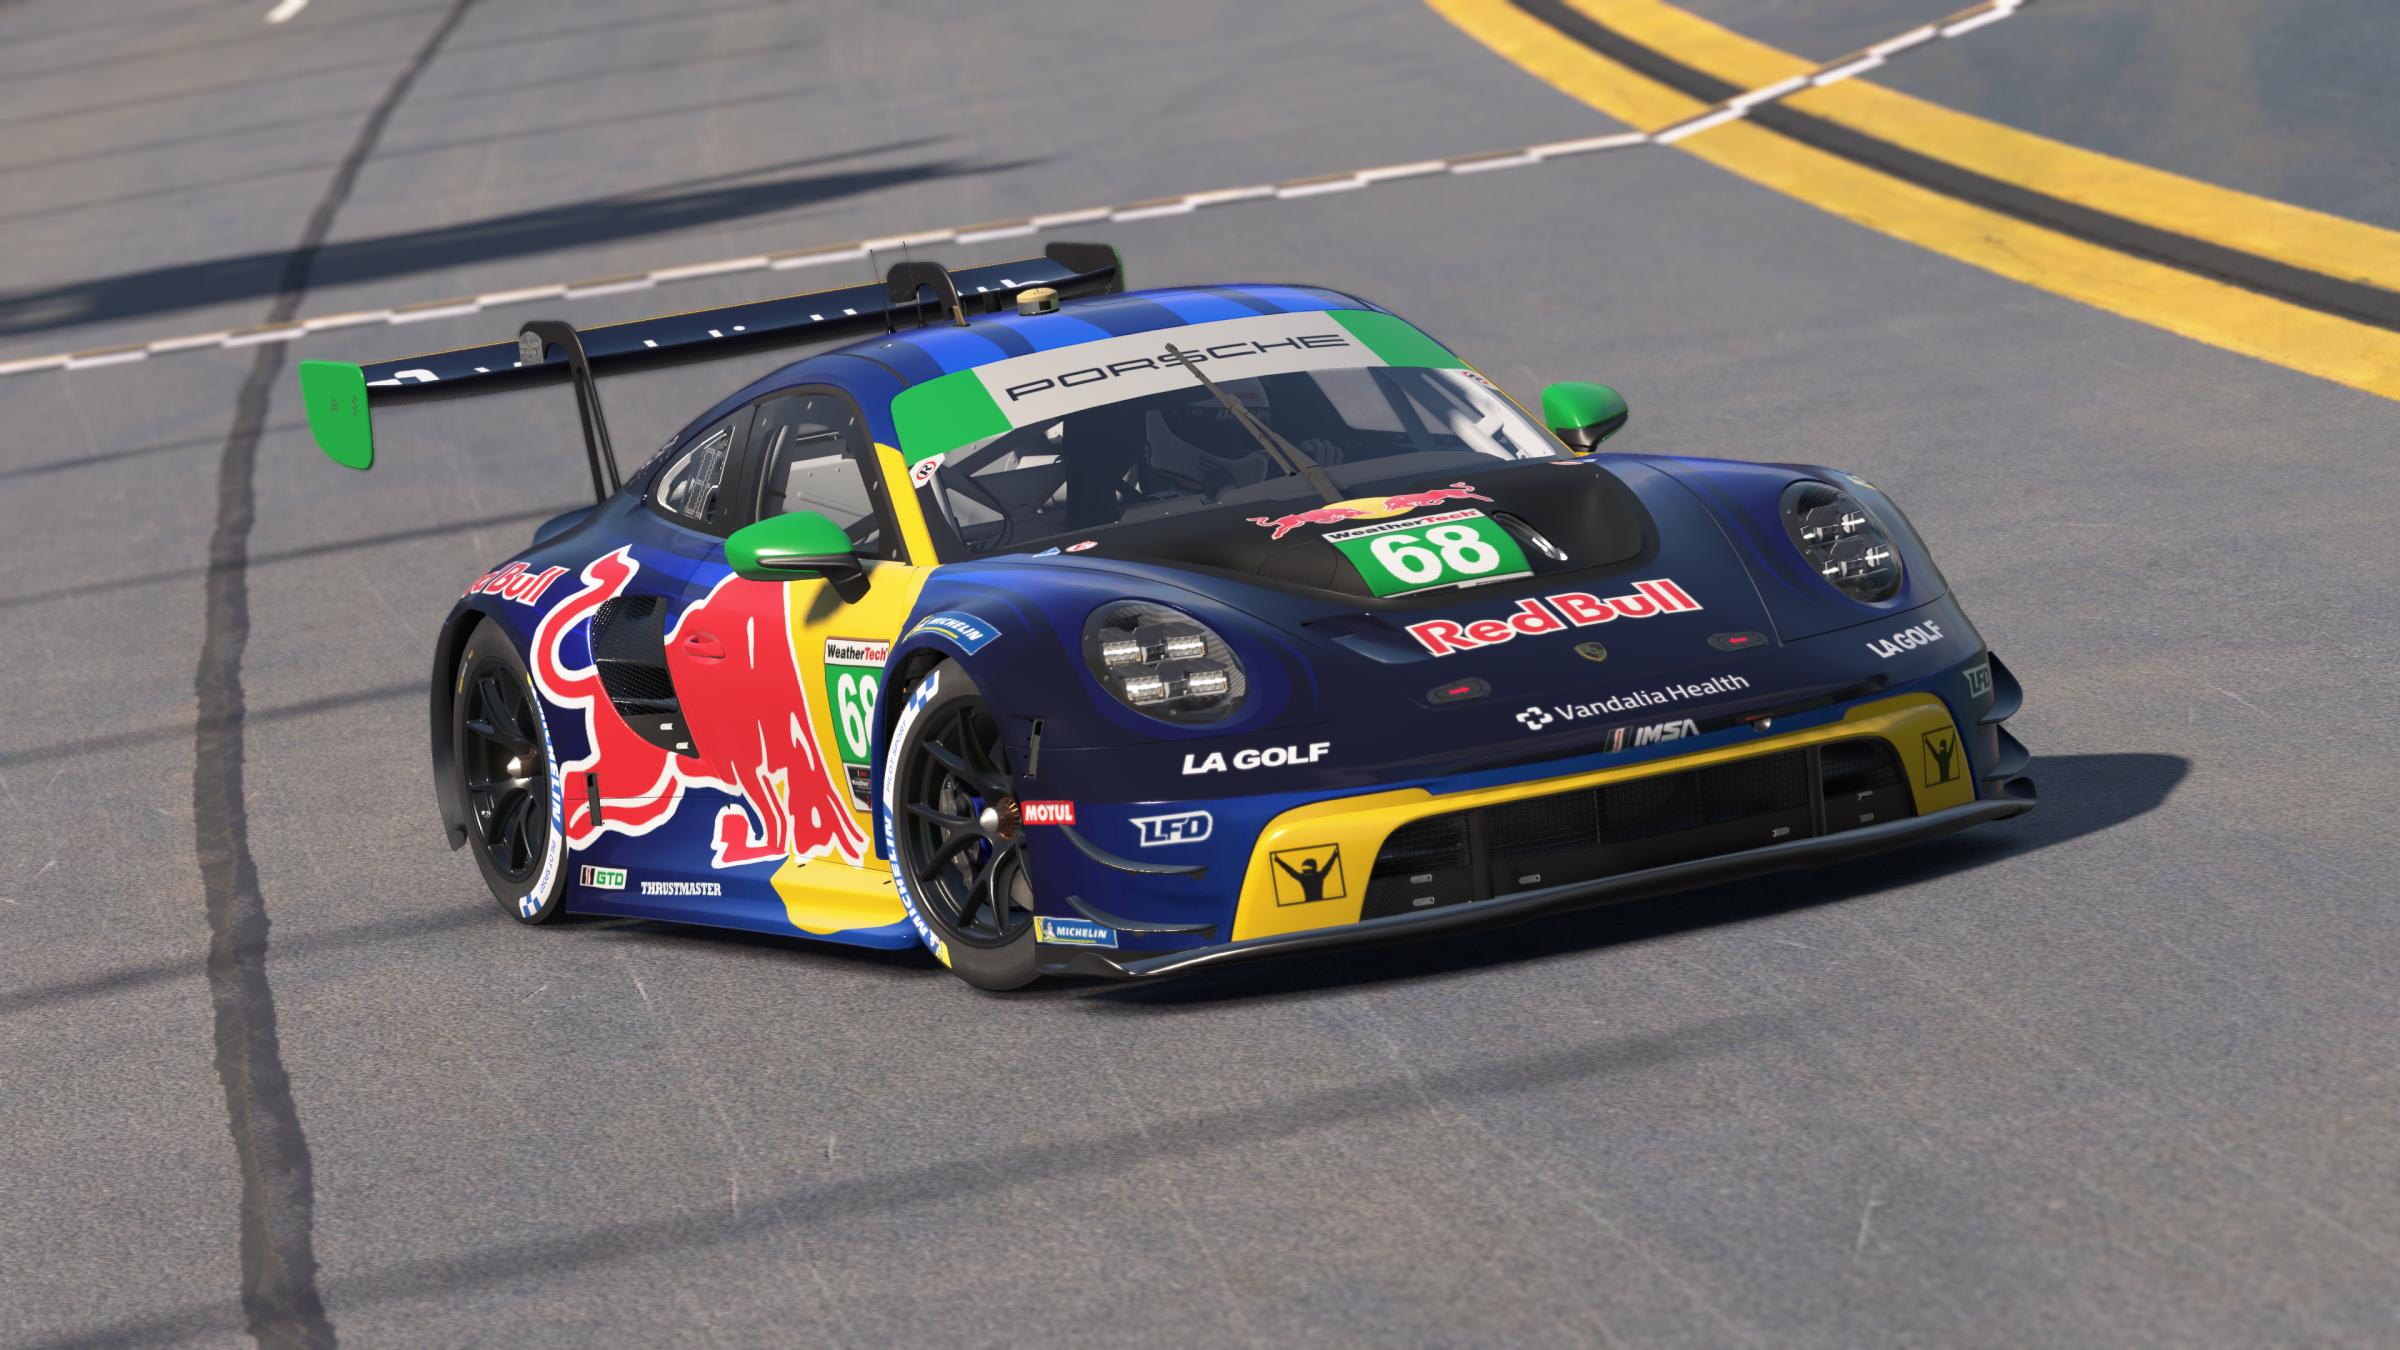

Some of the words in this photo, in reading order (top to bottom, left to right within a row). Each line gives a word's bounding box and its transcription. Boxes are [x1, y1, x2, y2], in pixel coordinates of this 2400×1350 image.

[1006, 334, 1350, 402] PORSCHE
[1329, 510, 1477, 541] WeatherTech
[1370, 525, 1500, 584] 68
[482, 562, 571, 606] Bull
[927, 617, 984, 641] MICHELIN
[1405, 598, 1568, 657] Red
[1545, 578, 1704, 627] Bull
[827, 643, 887, 662] WeatherTech
[1866, 639, 1904, 658] LA
[1893, 620, 1944, 649] GOLF
[1554, 690, 1669, 720] Vandalia
[1665, 674, 1750, 701] Health
[838, 673, 879, 758] 68
[1634, 718, 1699, 747] IMSA
[886, 760, 897, 792] PILOT
[892, 719, 908, 756] SPORT
[1182, 752, 1227, 775] LA
[1233, 742, 1331, 770] GOLF
[1025, 803, 1073, 822] MOTUL
[596, 871, 624, 886] GTD
[640, 881, 722, 896] THRUSTMASTER
[884, 815, 929, 941] MICHELIN
[1056, 926, 1108, 939] MICHELIN
